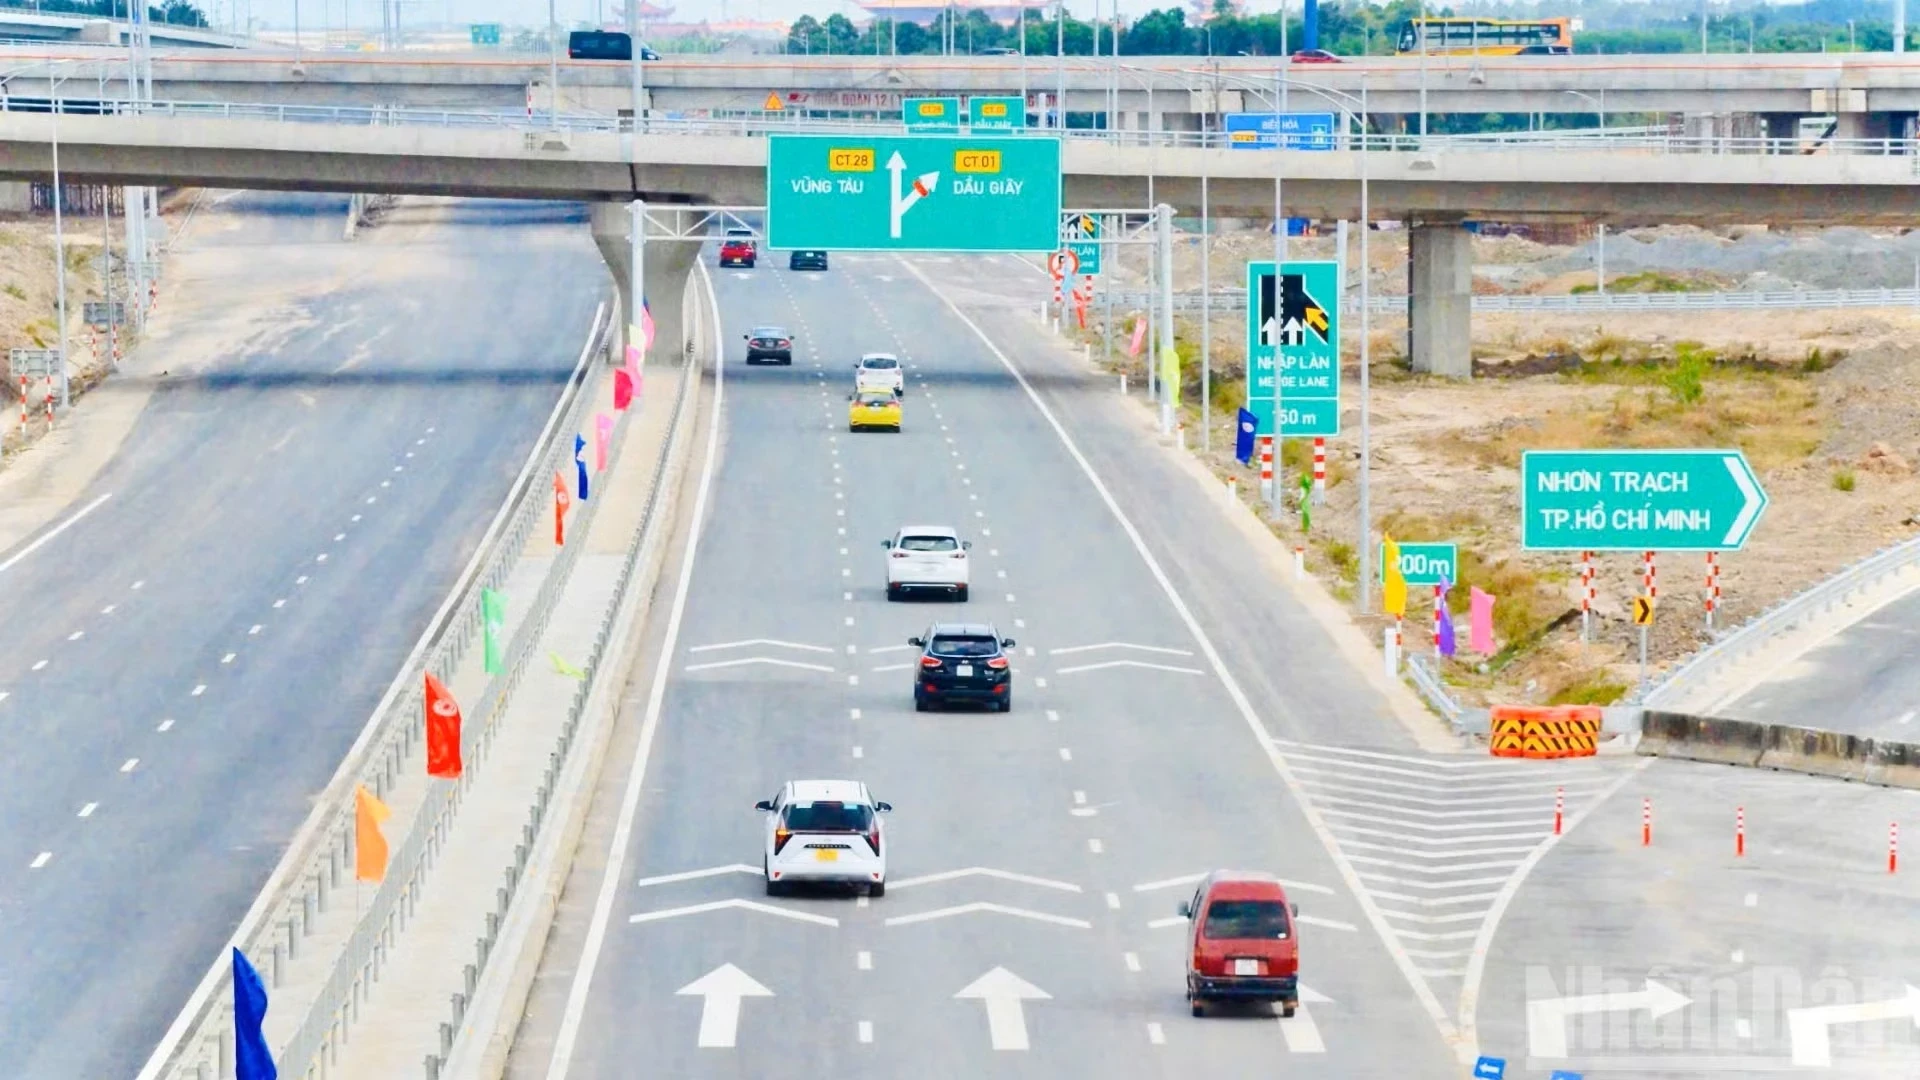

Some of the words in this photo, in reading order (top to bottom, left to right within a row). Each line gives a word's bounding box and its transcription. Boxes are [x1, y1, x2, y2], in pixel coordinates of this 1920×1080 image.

[836, 154, 868, 166] CT.28
[963, 155, 995, 168] CT.01
[791, 176, 832, 193] VŨNG
[837, 177, 864, 193] TÀU
[953, 175, 984, 195] DẦU
[1299, 351, 1330, 369] LÀN
[1299, 376, 1330, 387] LANE
[1302, 412, 1317, 425] m
[1537, 469, 1601, 493] NHƠN
[1610, 471, 1688, 498] TRẠCH
[1540, 500, 1606, 530] TP.HỒ
[1612, 502, 1649, 530] CHÍ
[1655, 509, 1711, 531] MINH
[1395, 553, 1450, 575] 00m
